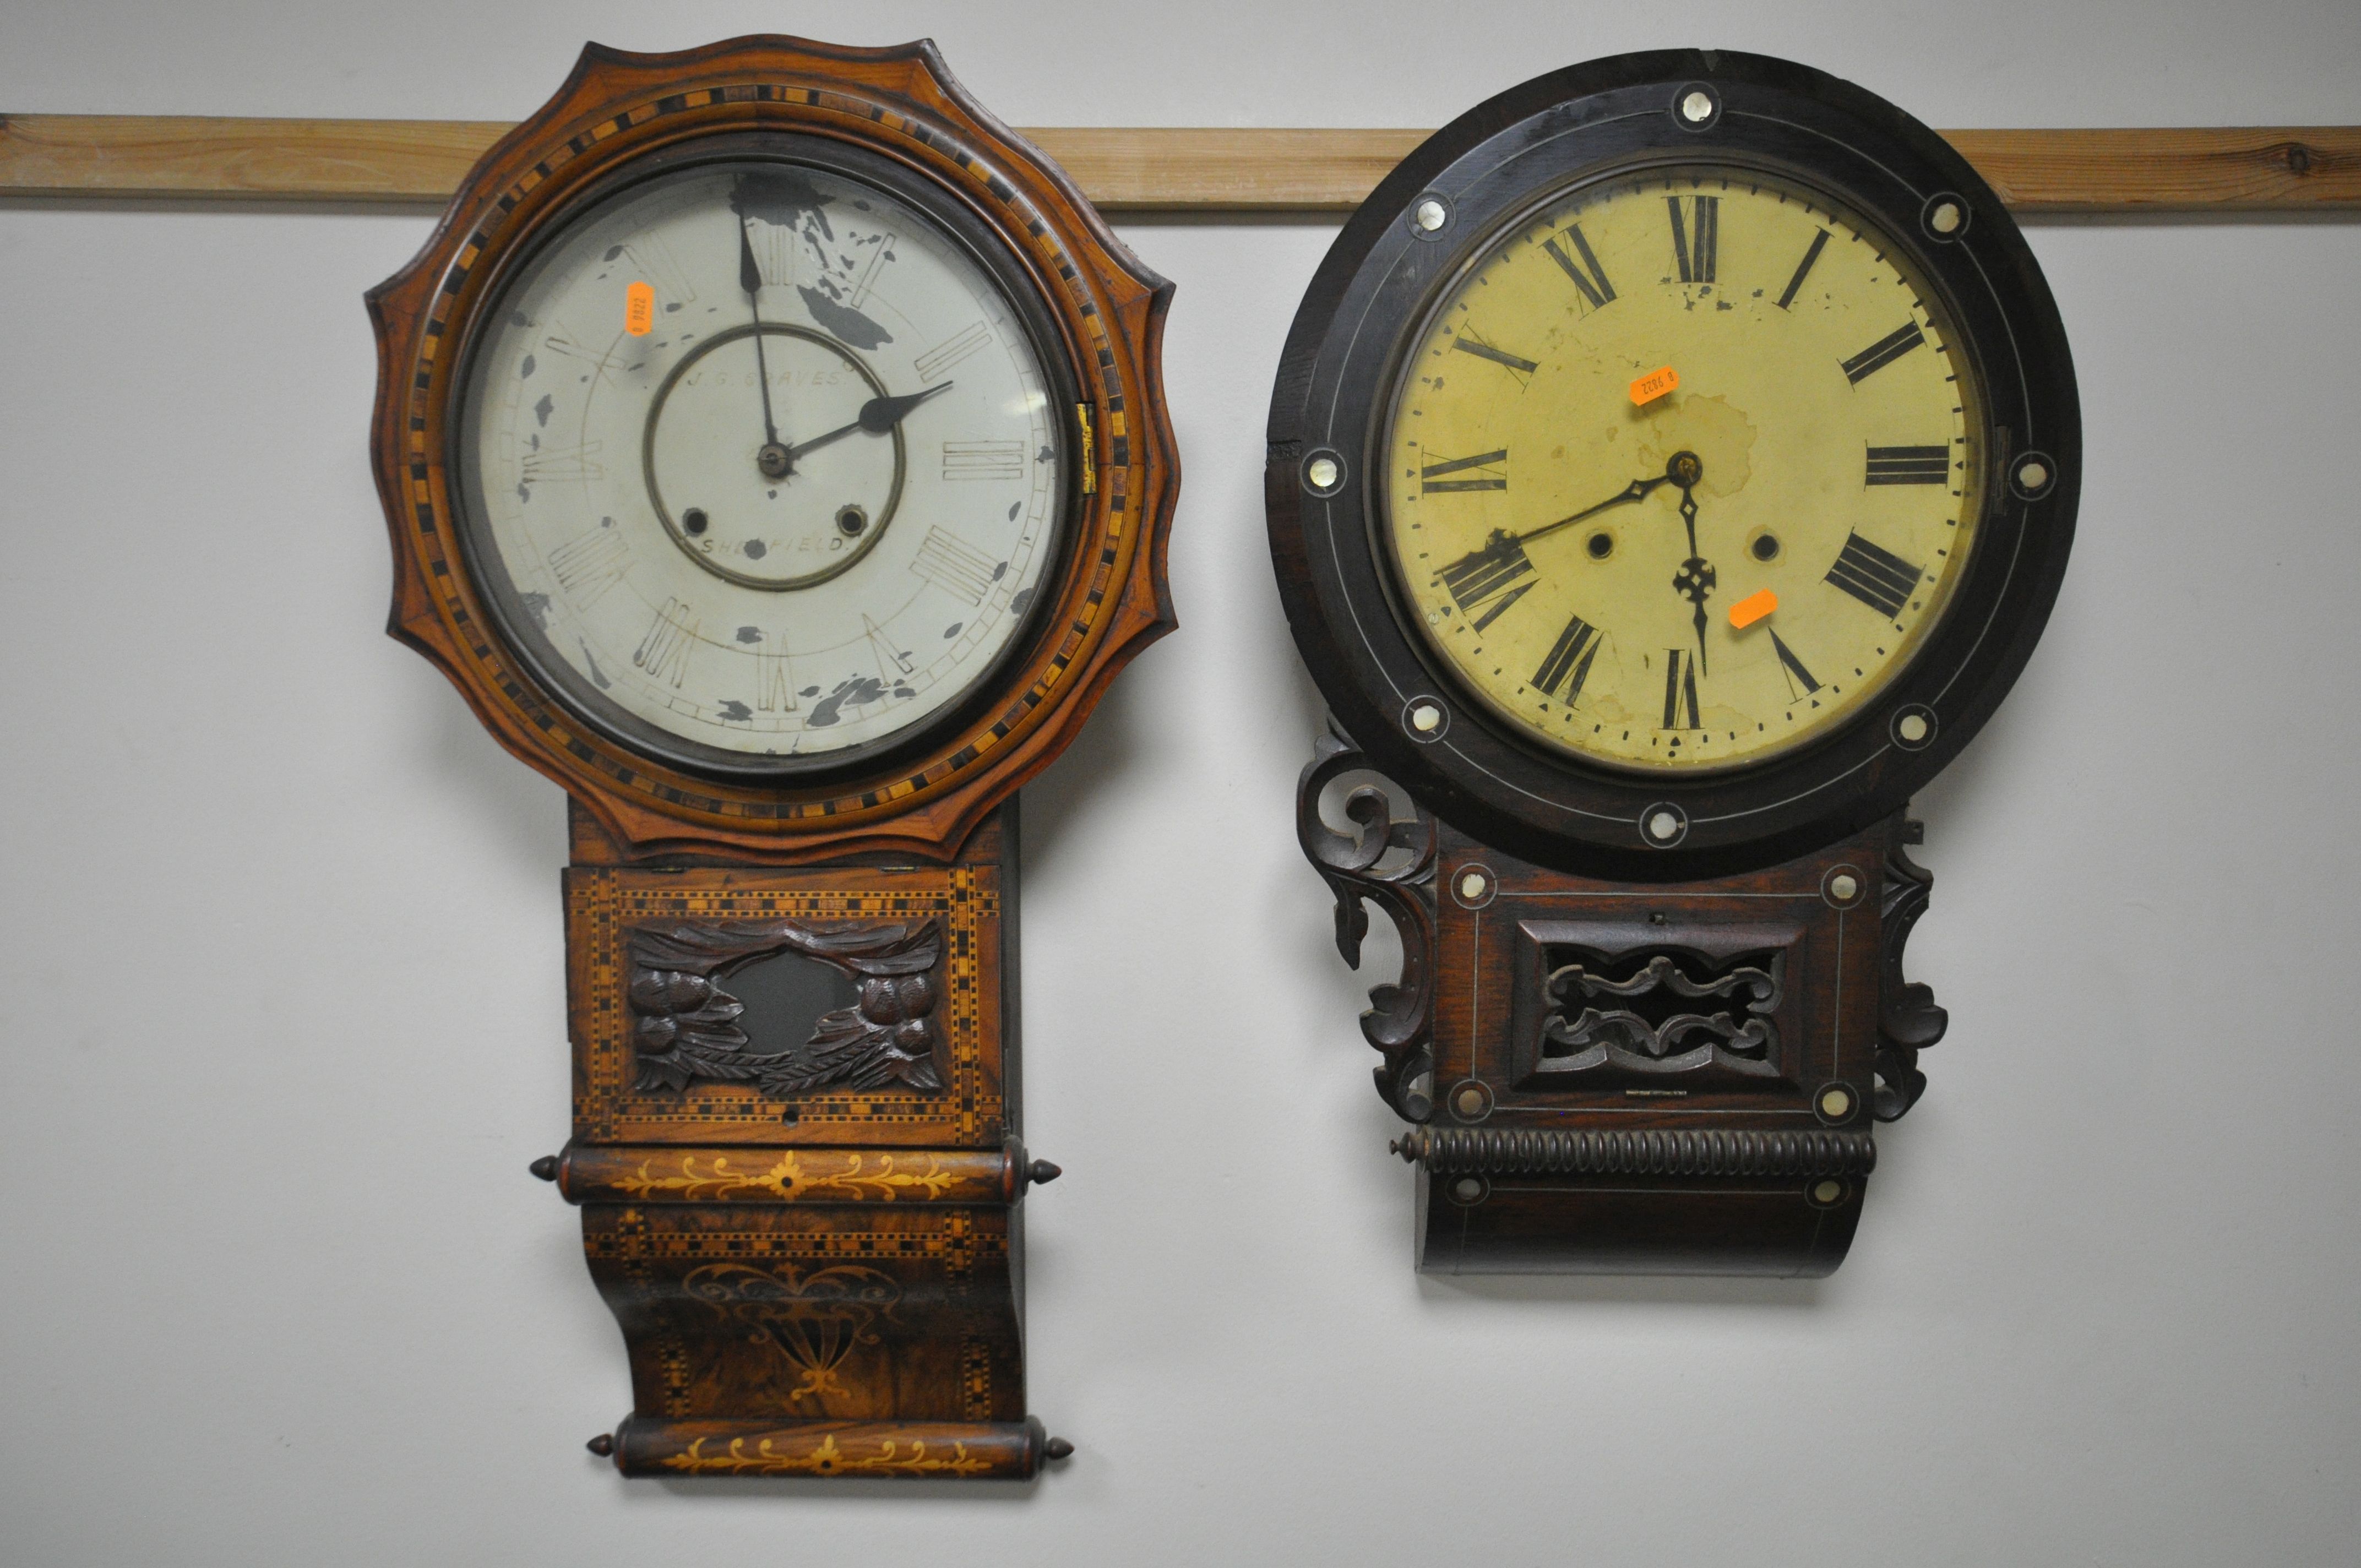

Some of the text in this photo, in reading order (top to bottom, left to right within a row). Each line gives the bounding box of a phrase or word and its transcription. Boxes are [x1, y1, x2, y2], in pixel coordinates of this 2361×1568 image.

[1538, 221, 1624, 321] XI
[1658, 195, 1723, 285] XII
[1771, 225, 1835, 313] I
[1449, 319, 1541, 394] X
[1641, 376, 1664, 394] 9822
[1837, 312, 1927, 393] II
[1422, 445, 1508, 499] IX
[1864, 438, 1950, 492] III
[1819, 523, 1927, 623] IIII
[1526, 611, 1604, 711] VII
[1658, 648, 1706, 730] VI
[1767, 626, 1826, 705] V
